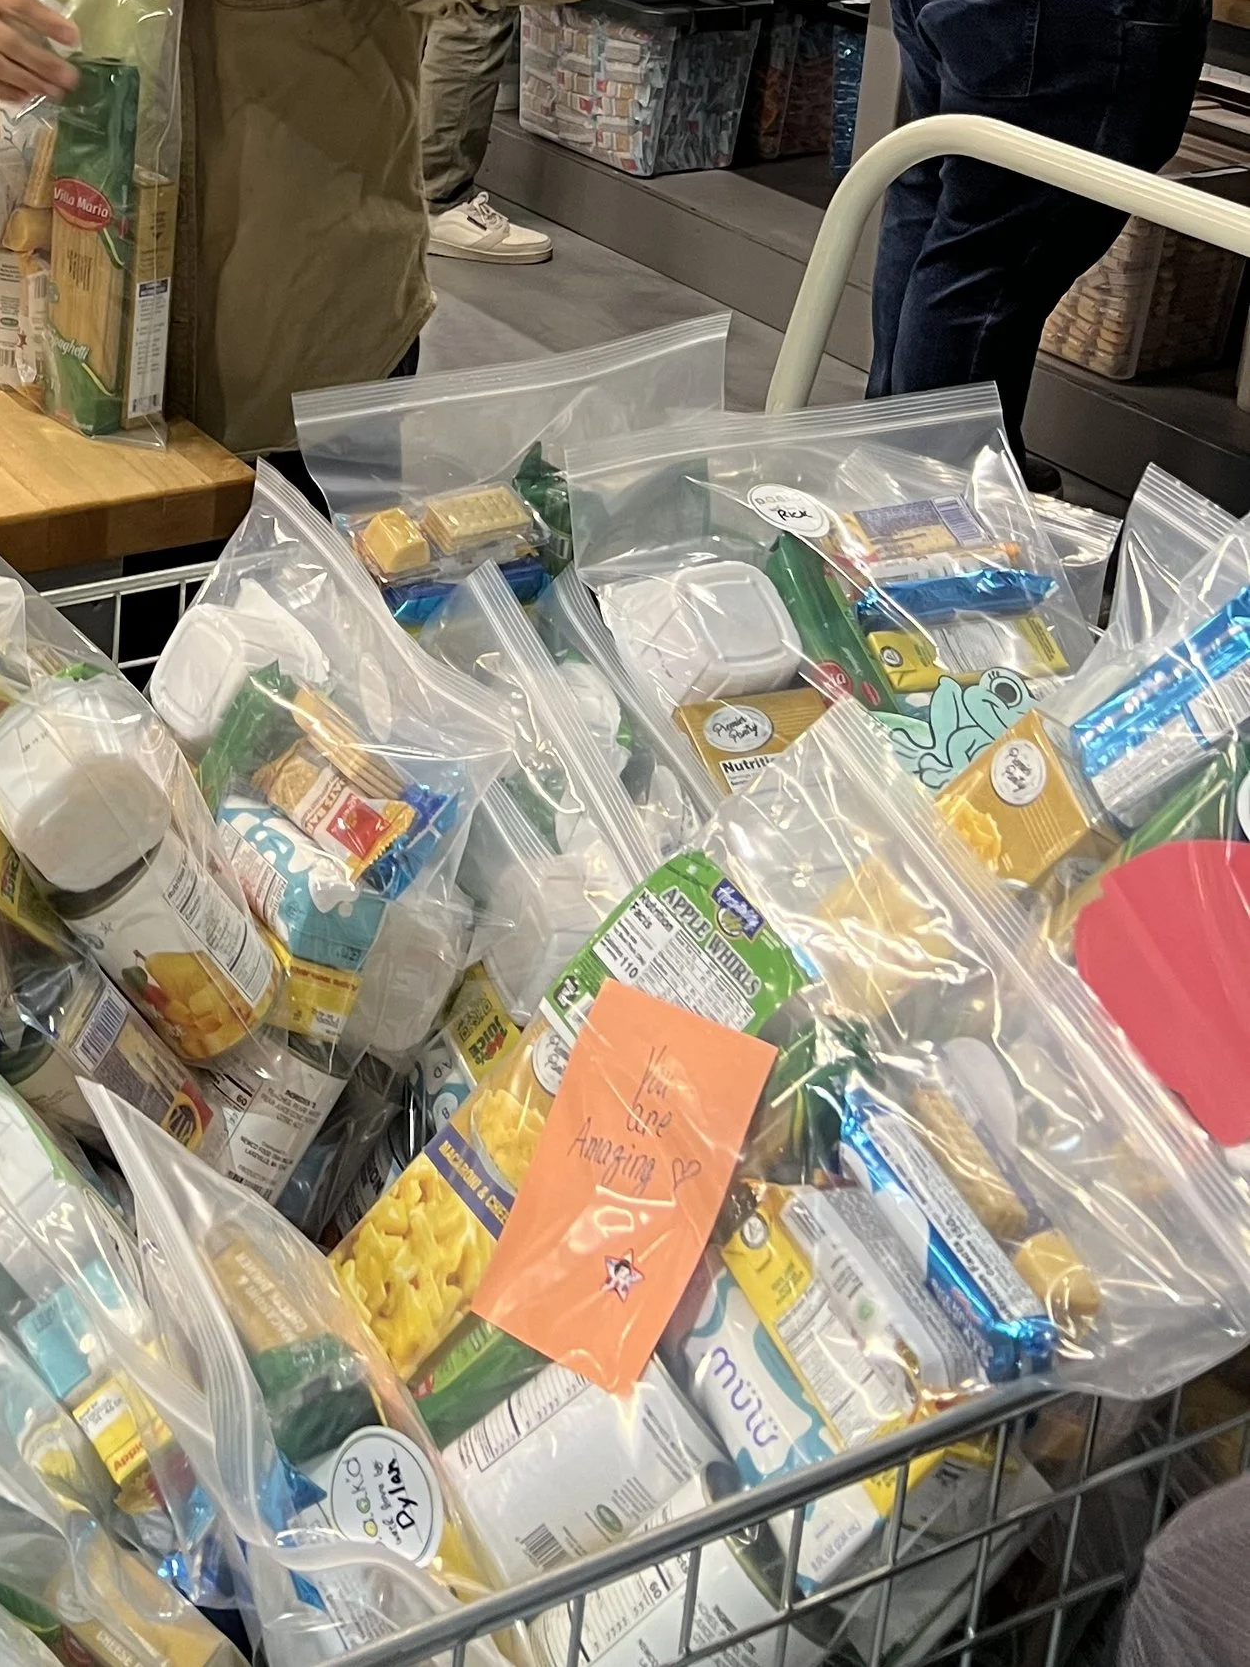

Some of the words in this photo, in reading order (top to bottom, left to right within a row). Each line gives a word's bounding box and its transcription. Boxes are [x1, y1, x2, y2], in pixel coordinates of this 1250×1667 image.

[53, 186, 75, 207] Villa
[77, 198, 109, 219] Maria
[630, 902, 652, 930] Facts
[638, 892, 674, 933] Nutrition
[660, 885, 713, 942] APPLE
[704, 930, 762, 999] WHIRLS
[619, 956, 638, 979] 110
[438, 1139, 483, 1192] MACARONI
[477, 1185, 489, 1201] &
[567, 1117, 656, 1197] Amazing
[952, 1241, 981, 1274] Facts
[388, 1458, 419, 1530] Dylan
